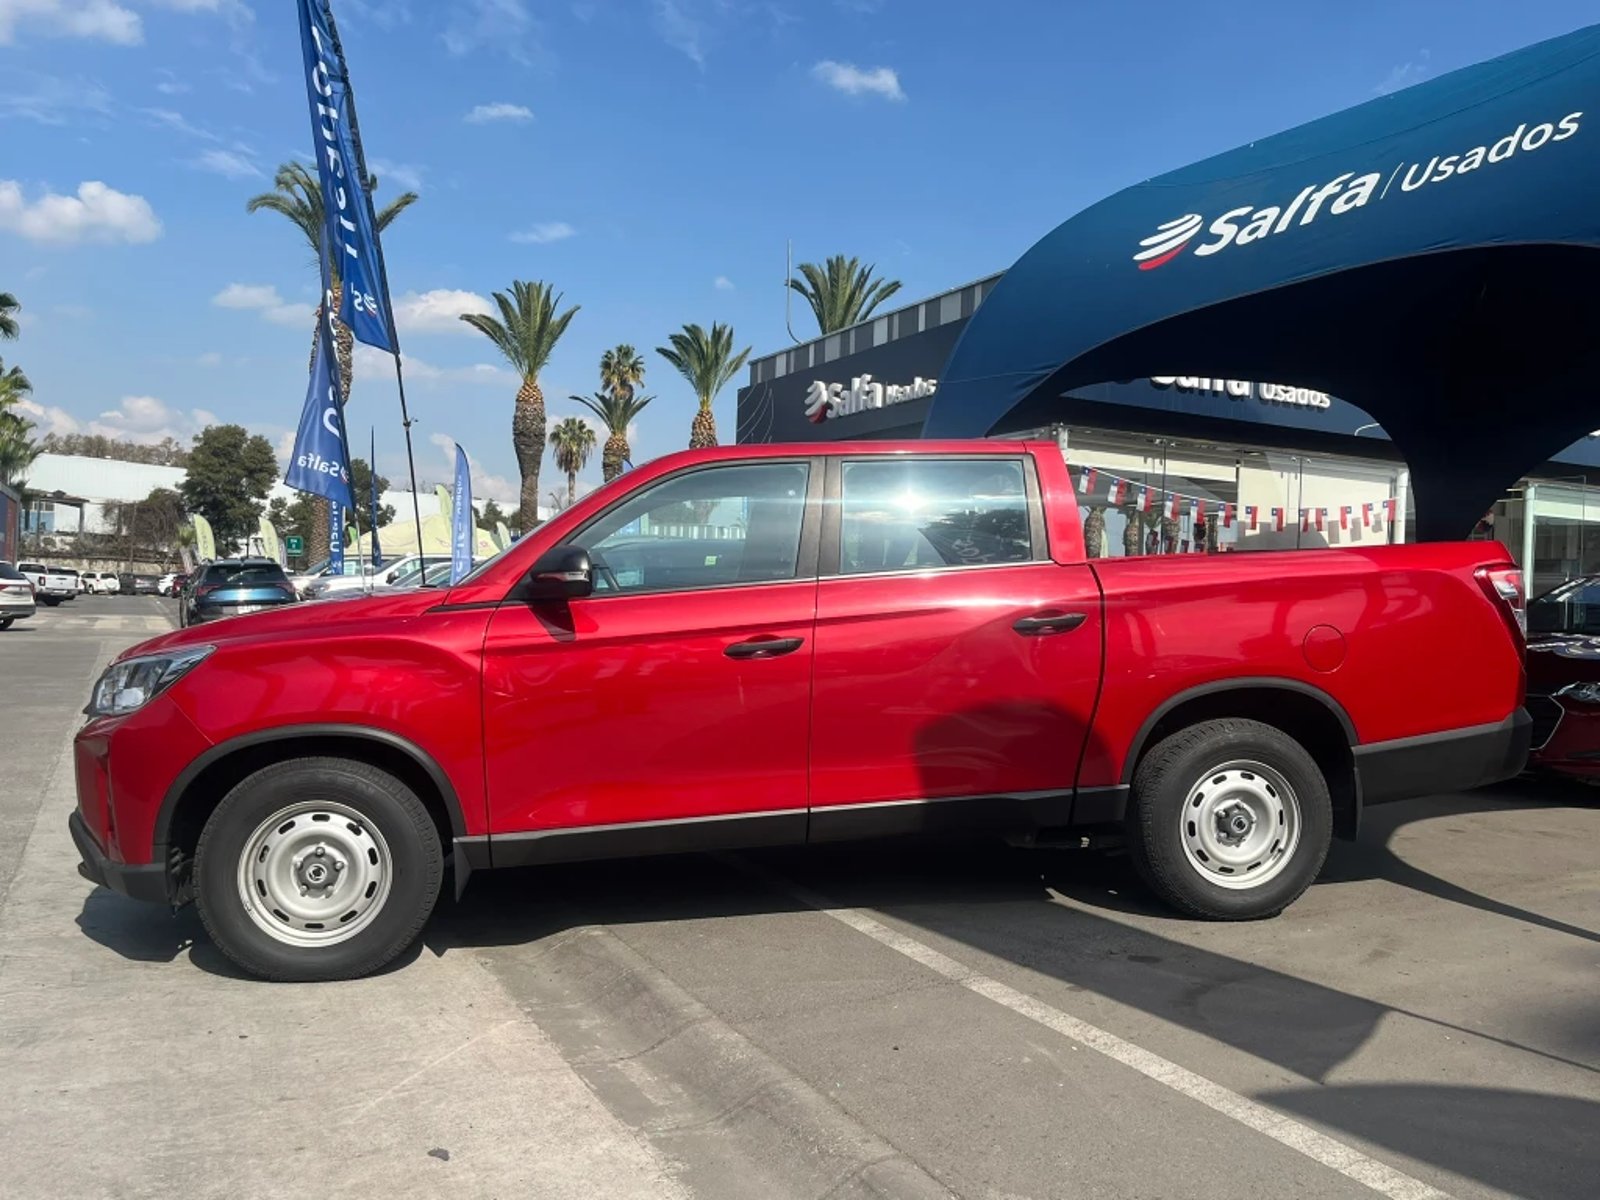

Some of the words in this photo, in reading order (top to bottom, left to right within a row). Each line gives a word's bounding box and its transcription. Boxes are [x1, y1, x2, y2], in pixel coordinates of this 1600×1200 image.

[1193, 171, 1382, 257] Salfa
[1400, 111, 1584, 192] Usados
[826, 373, 884, 419] Salfa
[886, 376, 938, 405] Usados
